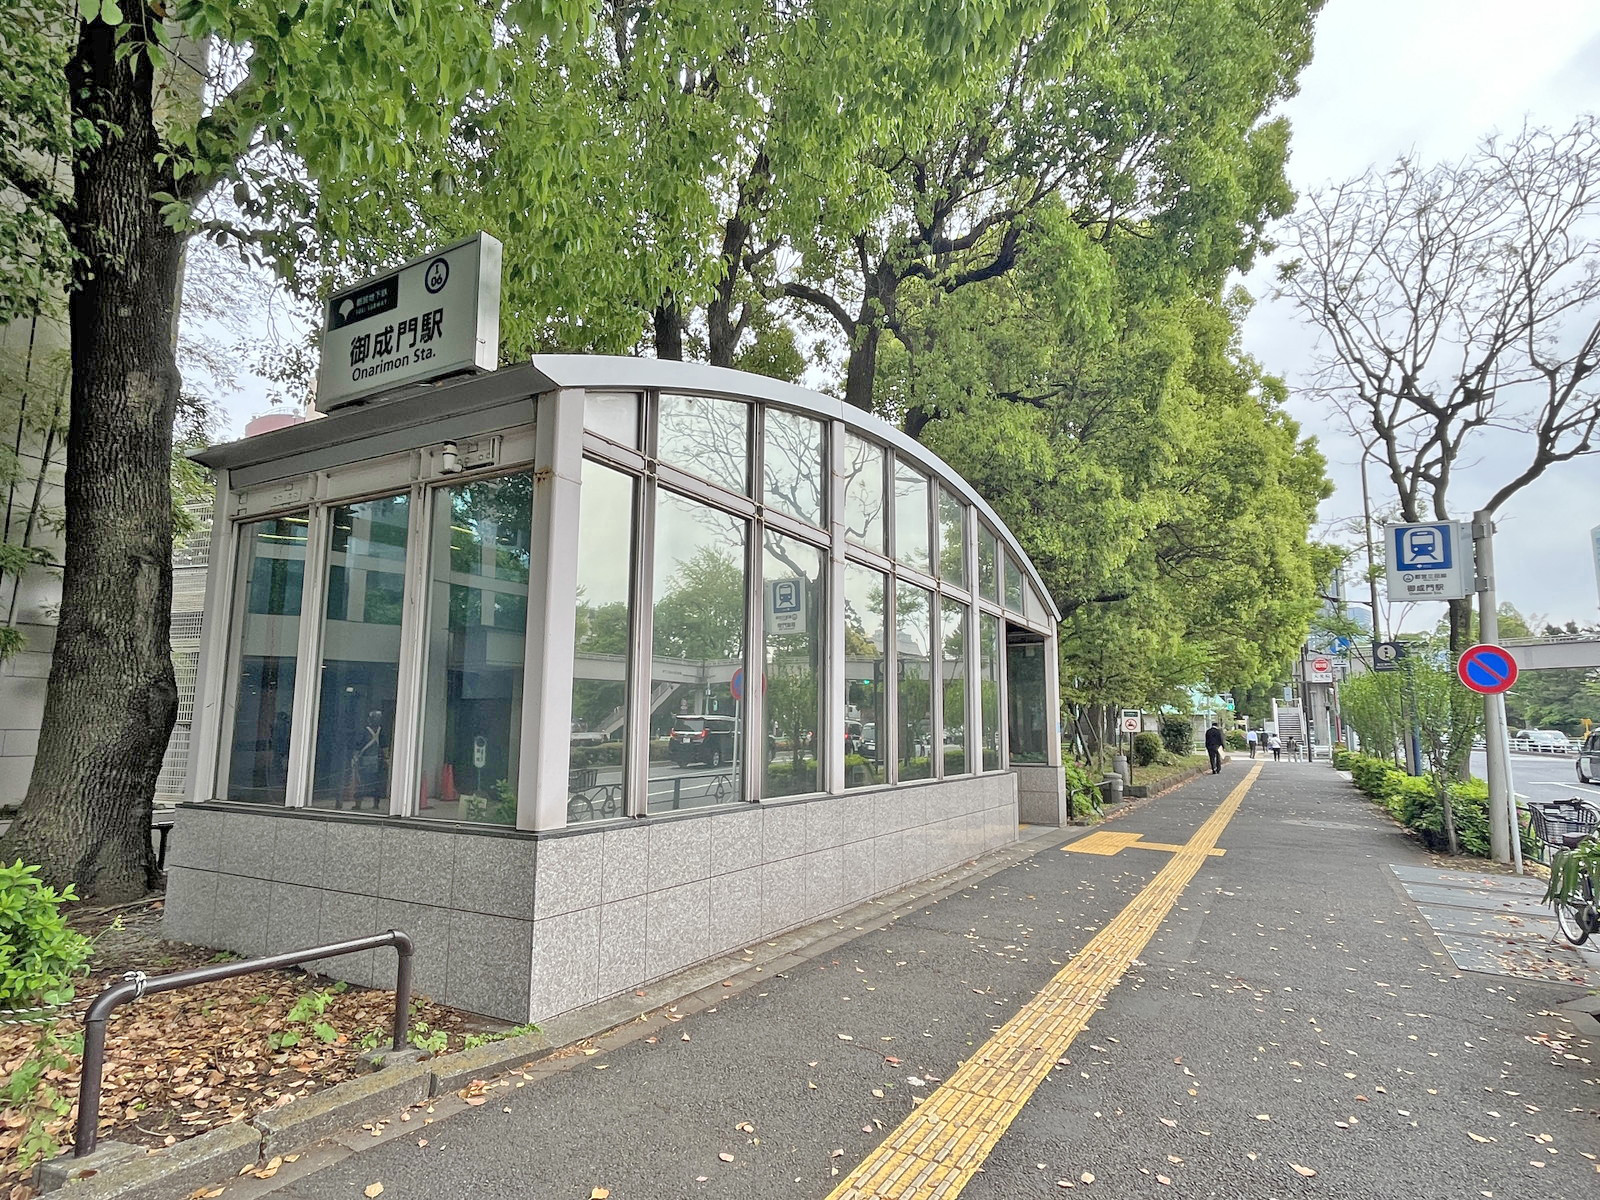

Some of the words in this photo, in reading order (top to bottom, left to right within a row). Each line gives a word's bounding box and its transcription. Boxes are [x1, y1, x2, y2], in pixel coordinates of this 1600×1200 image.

[431, 273, 443, 288] 06
[350, 308, 444, 367] 御成門駅
[352, 355, 409, 382] Onarimon
[413, 348, 436, 363] Sta.
